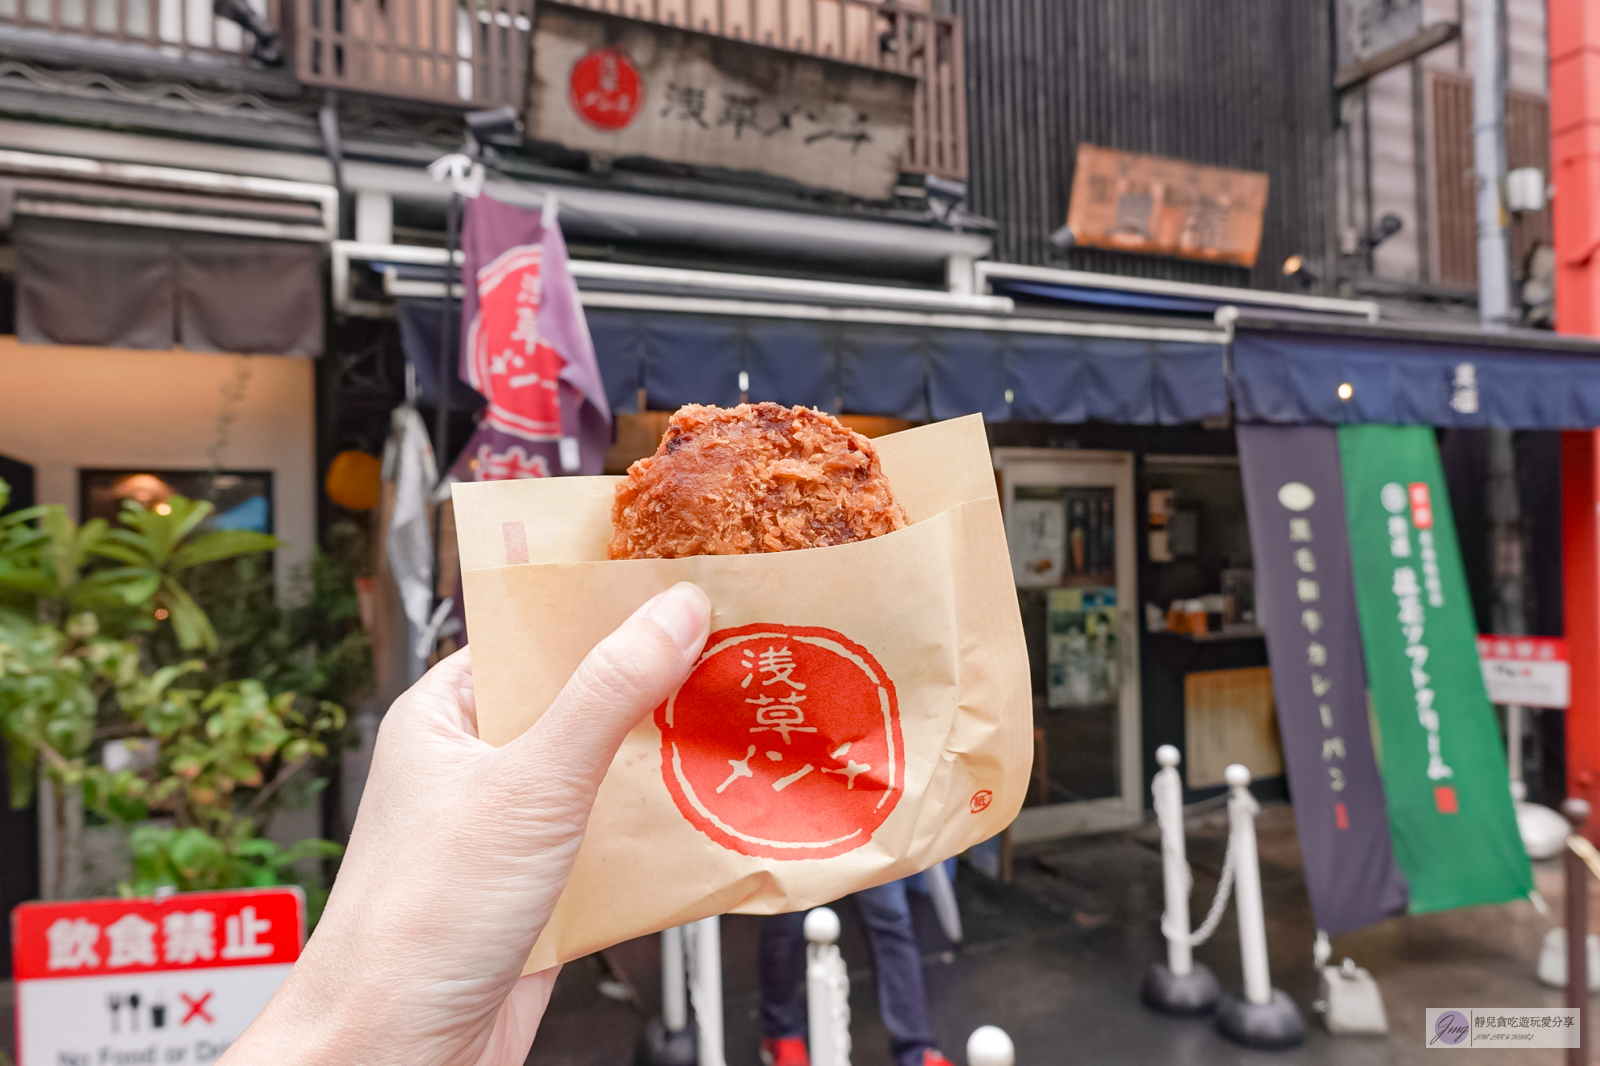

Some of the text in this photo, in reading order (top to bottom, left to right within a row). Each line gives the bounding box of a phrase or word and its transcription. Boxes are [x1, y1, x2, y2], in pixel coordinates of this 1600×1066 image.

[660, 82, 873, 156] 浅草メンチ
[1289, 517, 1346, 791] 黒毛和牛カレーパン
[741, 646, 818, 745] 浅草
[716, 740, 871, 793] メンチ
[46, 905, 275, 970] 飲食禁止
